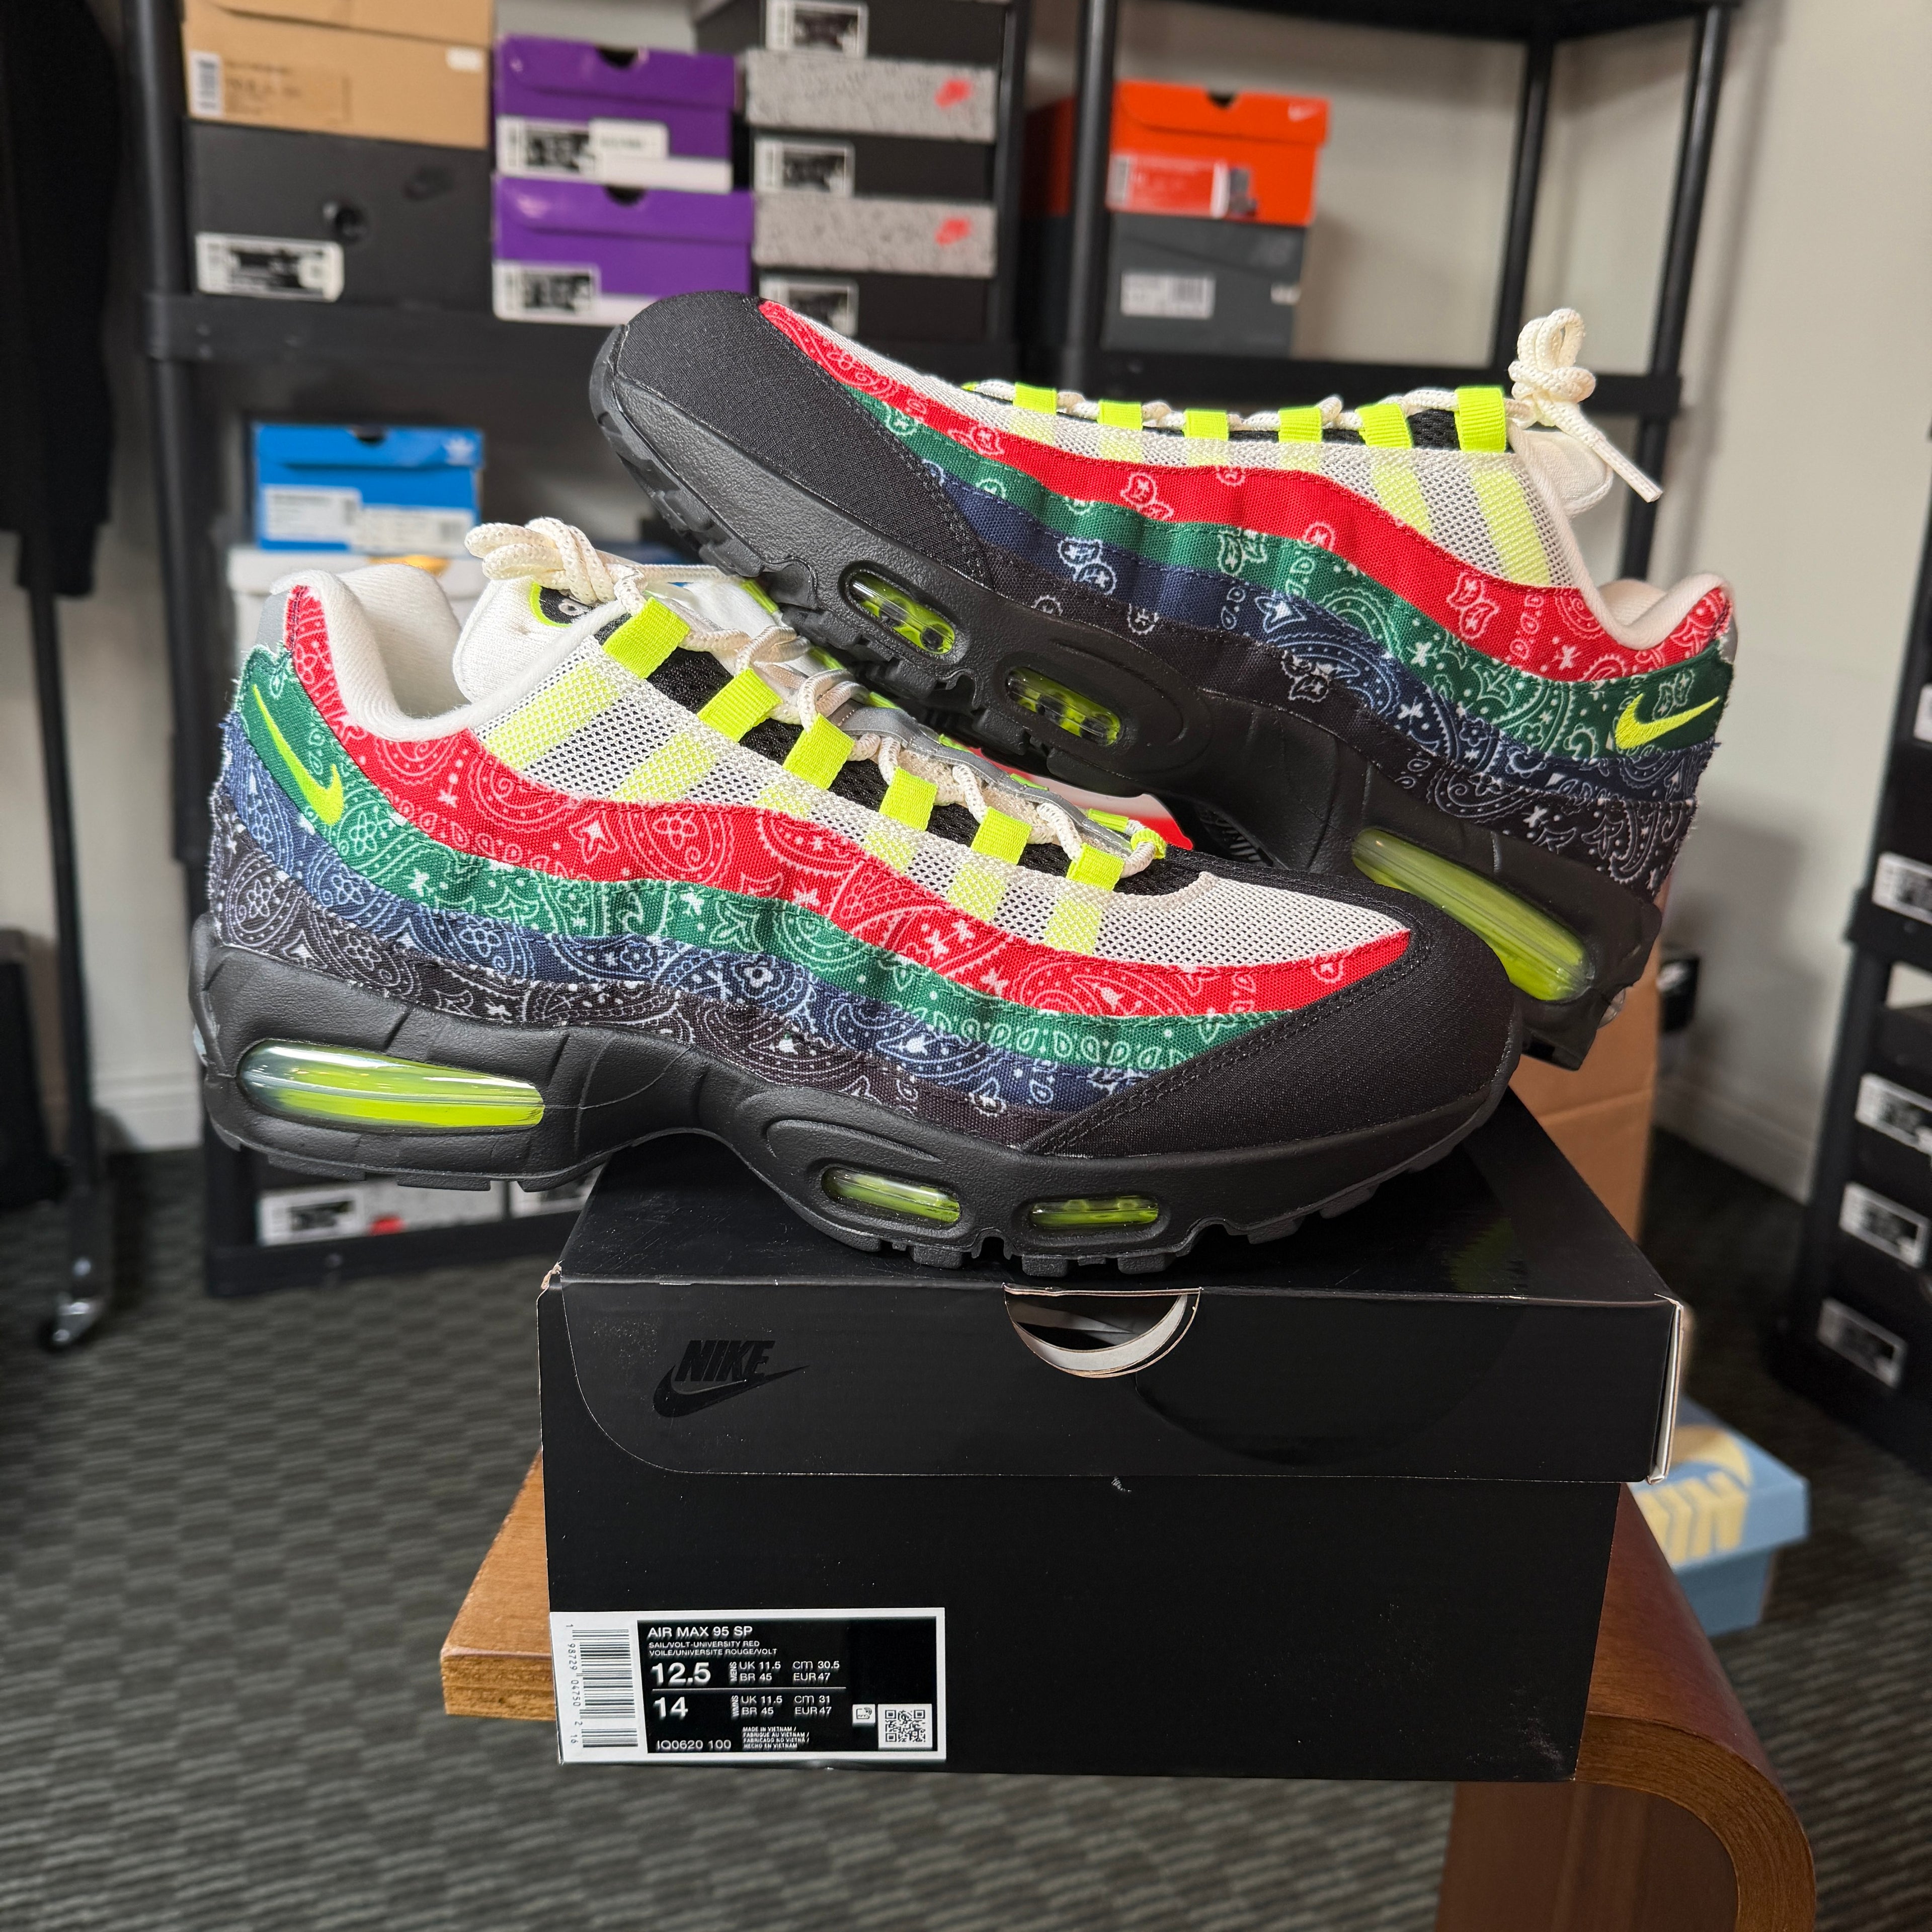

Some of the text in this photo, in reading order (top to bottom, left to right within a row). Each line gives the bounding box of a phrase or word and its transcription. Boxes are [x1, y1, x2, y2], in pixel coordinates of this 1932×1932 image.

[674, 1340, 775, 1382] NIKE
[648, 1626, 753, 1637] AIR MAX 95 SP
[568, 1643, 578, 1670] 98729
[652, 1662, 711, 1684] 12.5
[739, 1661, 755, 1669] UK
[759, 1661, 781, 1669] 11.5
[818, 1661, 840, 1669] 30.5
[740, 1672, 830, 1681] BR 45 EUR 47
[571, 1679, 581, 1707] 04750
[741, 1696, 757, 1704] UK
[760, 1696, 782, 1704] 11.5
[819, 1695, 830, 1704] 31
[654, 1697, 688, 1718] 14
[732, 1695, 740, 1717] WMNS
[742, 1706, 832, 1715] BR 45 EUR 47
[656, 1740, 732, 1750] IQ0620 100
